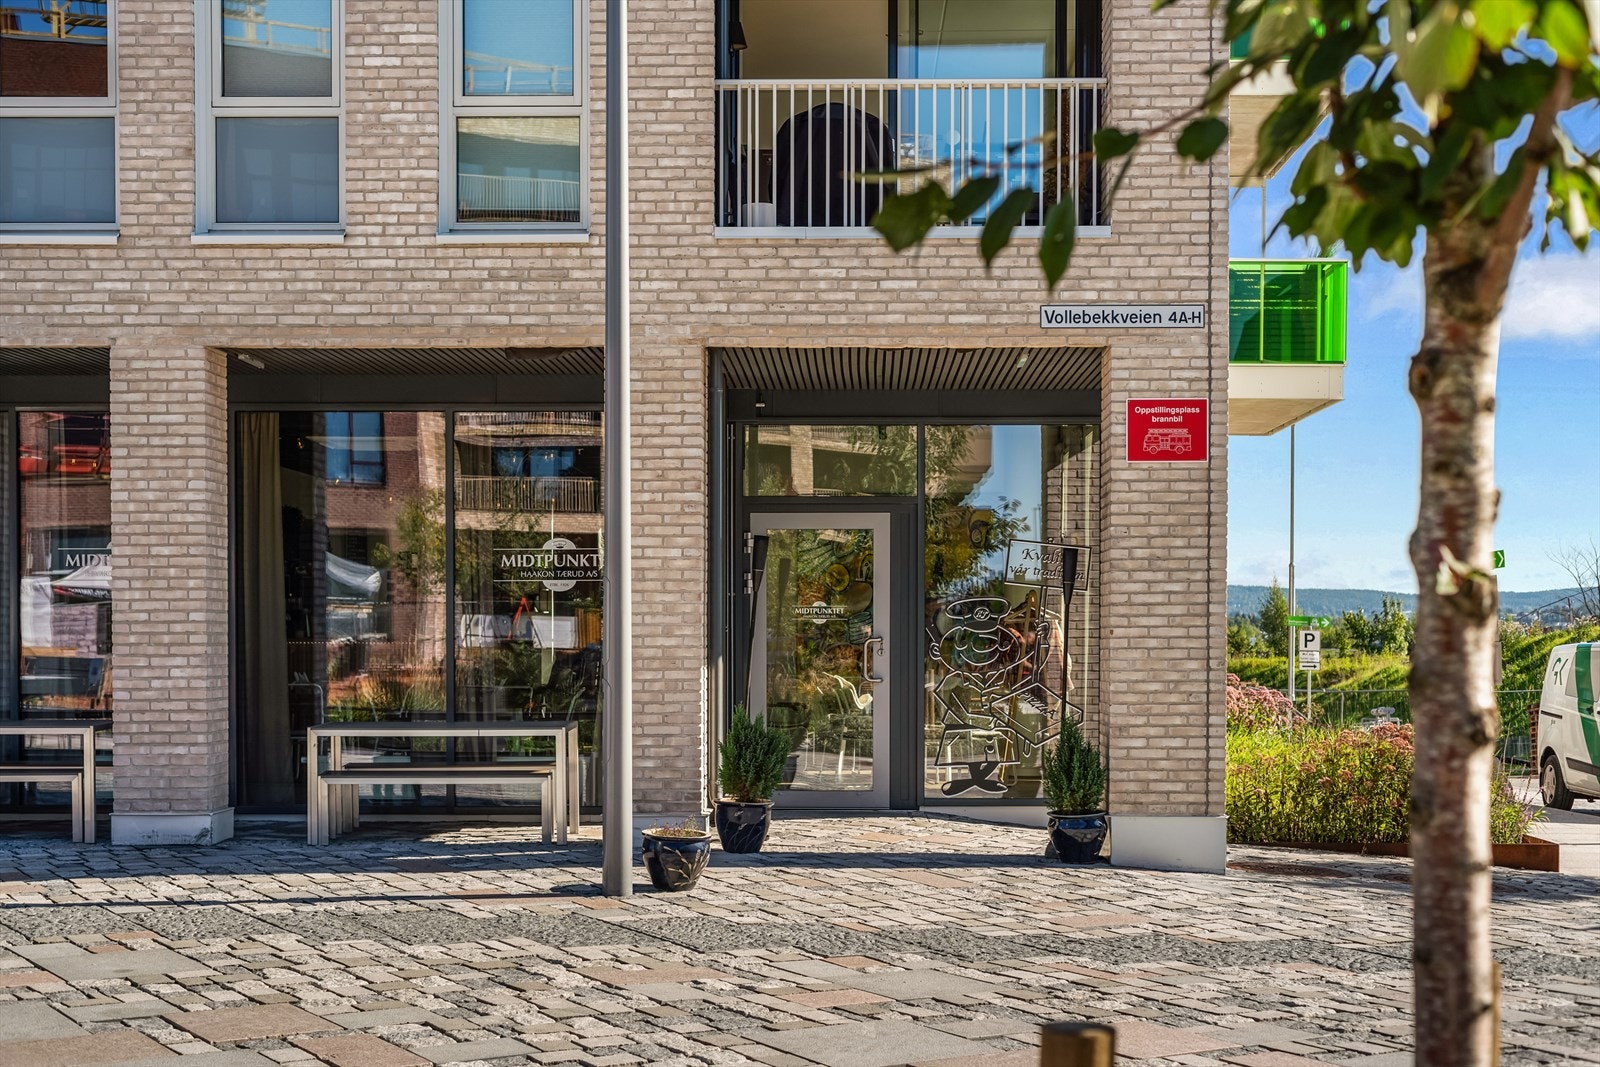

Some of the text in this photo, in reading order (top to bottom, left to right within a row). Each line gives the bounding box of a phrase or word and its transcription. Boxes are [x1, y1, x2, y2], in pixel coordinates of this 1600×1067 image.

[1044, 309, 1202, 324] Vollebekkveien 4A-H
[1134, 406, 1200, 415] Oppstillingsplass
[1151, 415, 1183, 423] brannbil
[501, 553, 603, 568] MIDTPUNKT
[520, 570, 555, 578] HAAKON
[556, 570, 584, 578] TÆRUD
[794, 607, 845, 615] MIDTPUNKTET
[1304, 632, 1316, 648] P
[1017, 691, 1056, 720] PIZZA
